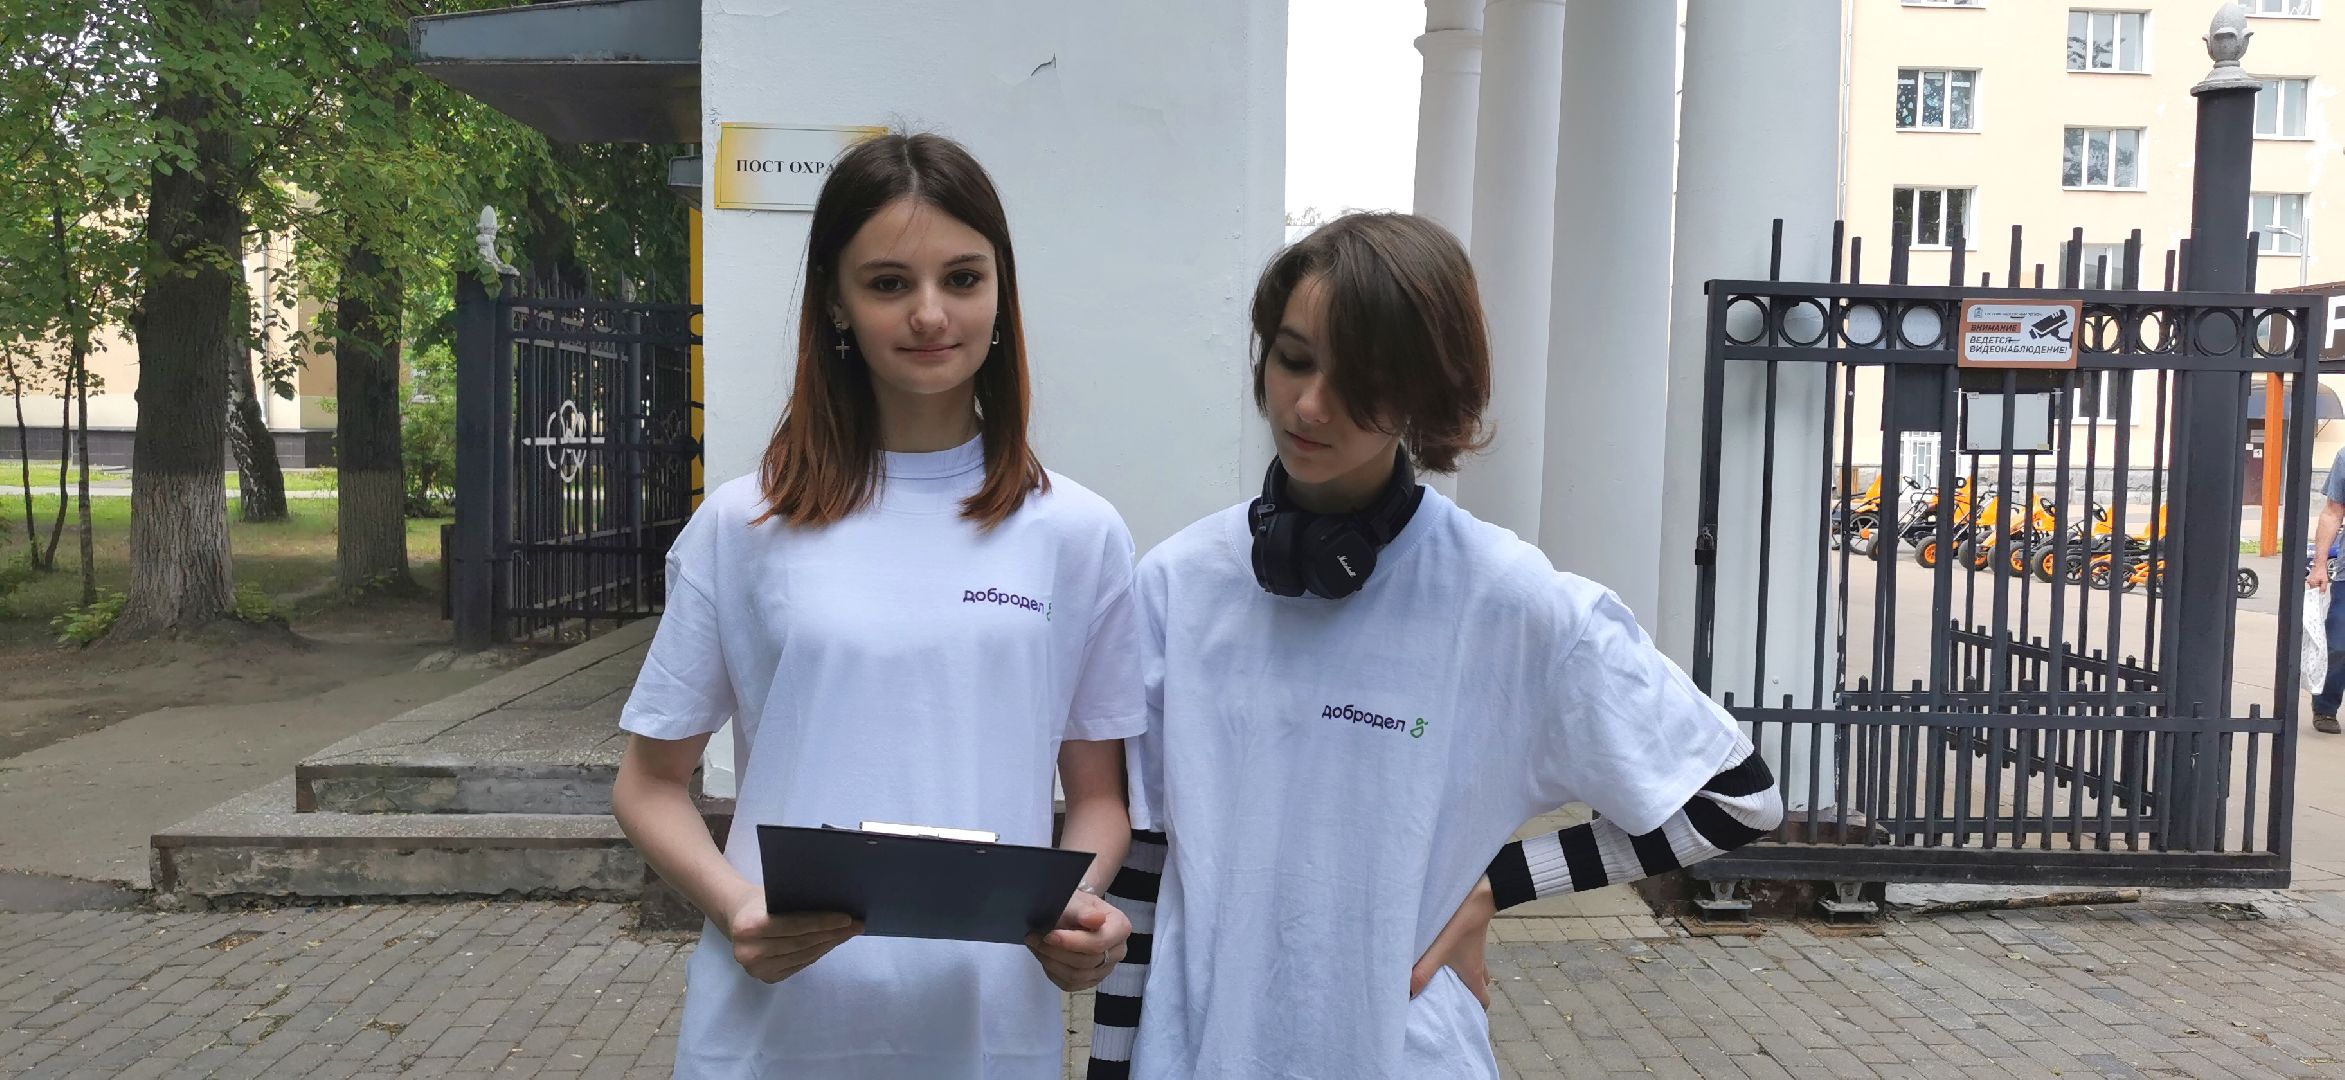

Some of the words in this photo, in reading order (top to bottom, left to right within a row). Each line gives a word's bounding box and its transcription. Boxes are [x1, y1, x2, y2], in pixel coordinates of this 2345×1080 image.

[736, 159, 784, 173] ПОСТ
[1970, 324, 2017, 332] ВНИМАНИЕ
[1969, 336, 2012, 344] ВЕДЕТСЯ
[1969, 345, 2068, 354] ВИДЕОНАБЛЮДЕНИЕ!
[963, 588, 1044, 614] добродел
[1322, 705, 1405, 732] добродел
